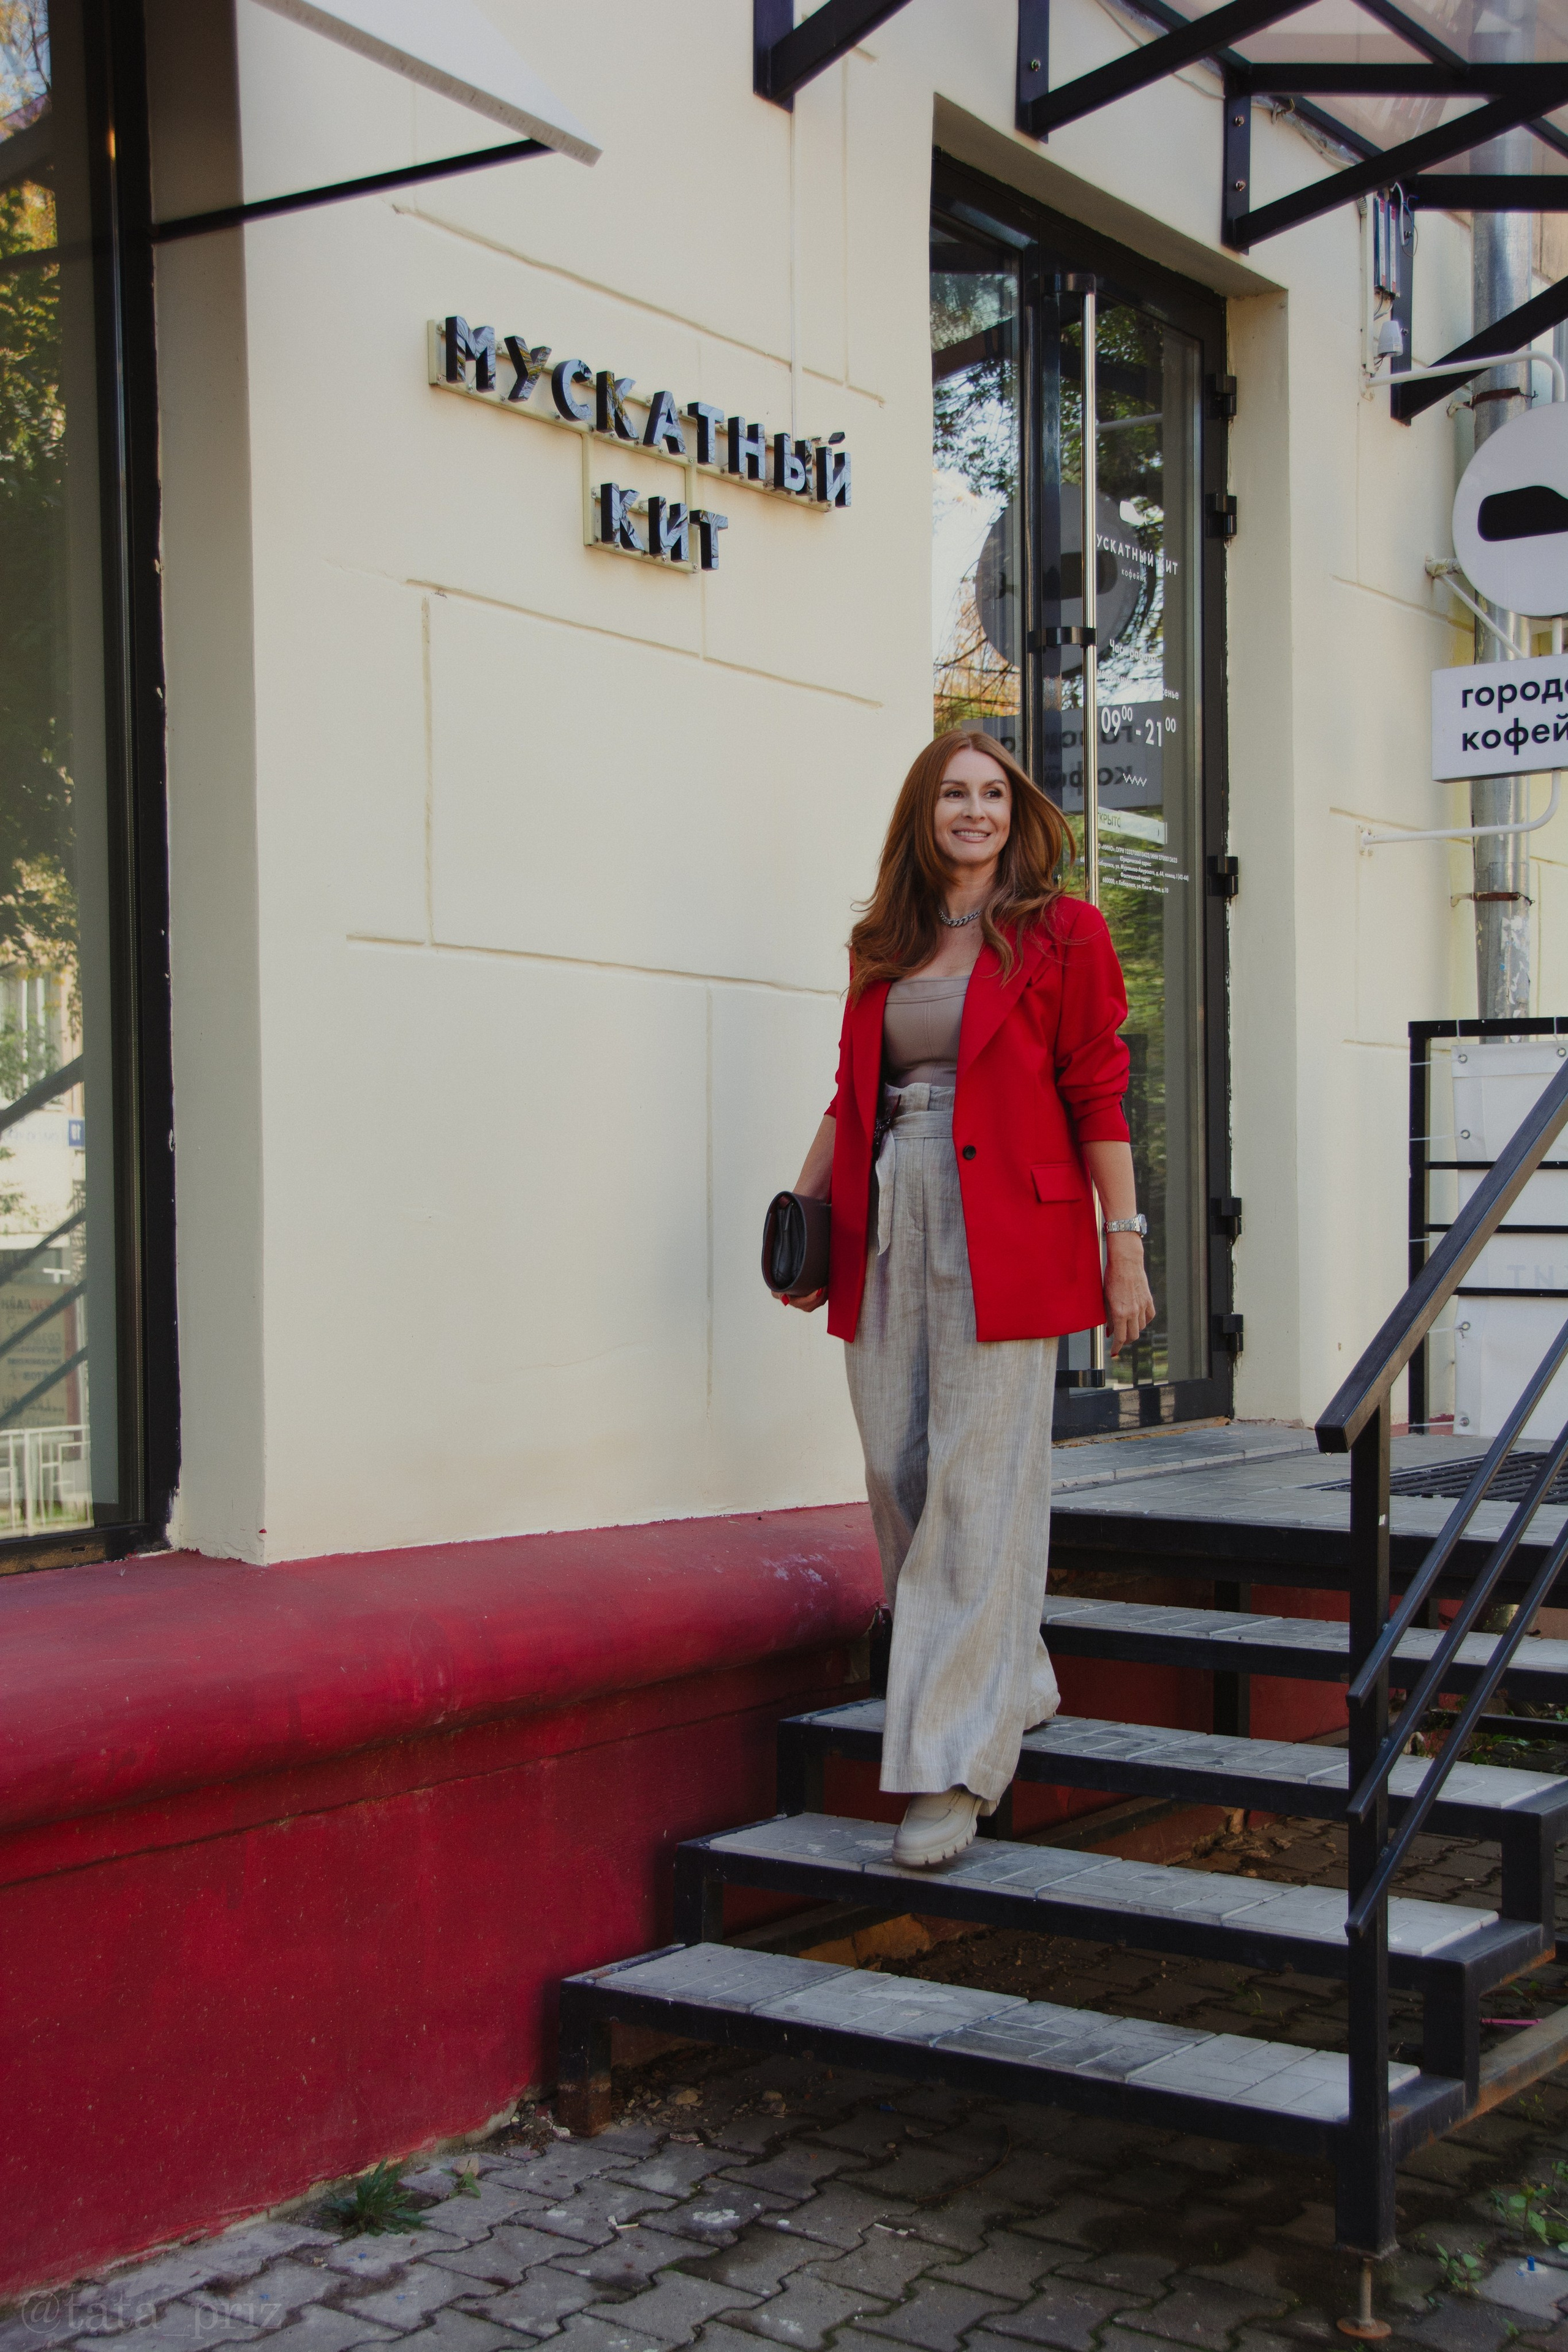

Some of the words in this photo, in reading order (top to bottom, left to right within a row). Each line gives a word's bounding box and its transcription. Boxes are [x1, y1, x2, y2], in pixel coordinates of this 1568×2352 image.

[445, 315, 851, 508] МУСКАТНЫЙ
[600, 482, 728, 571] КИТ
[1096, 533, 1154, 567] УСКАТНЫЙ
[1121, 568, 1147, 582] кофейня
